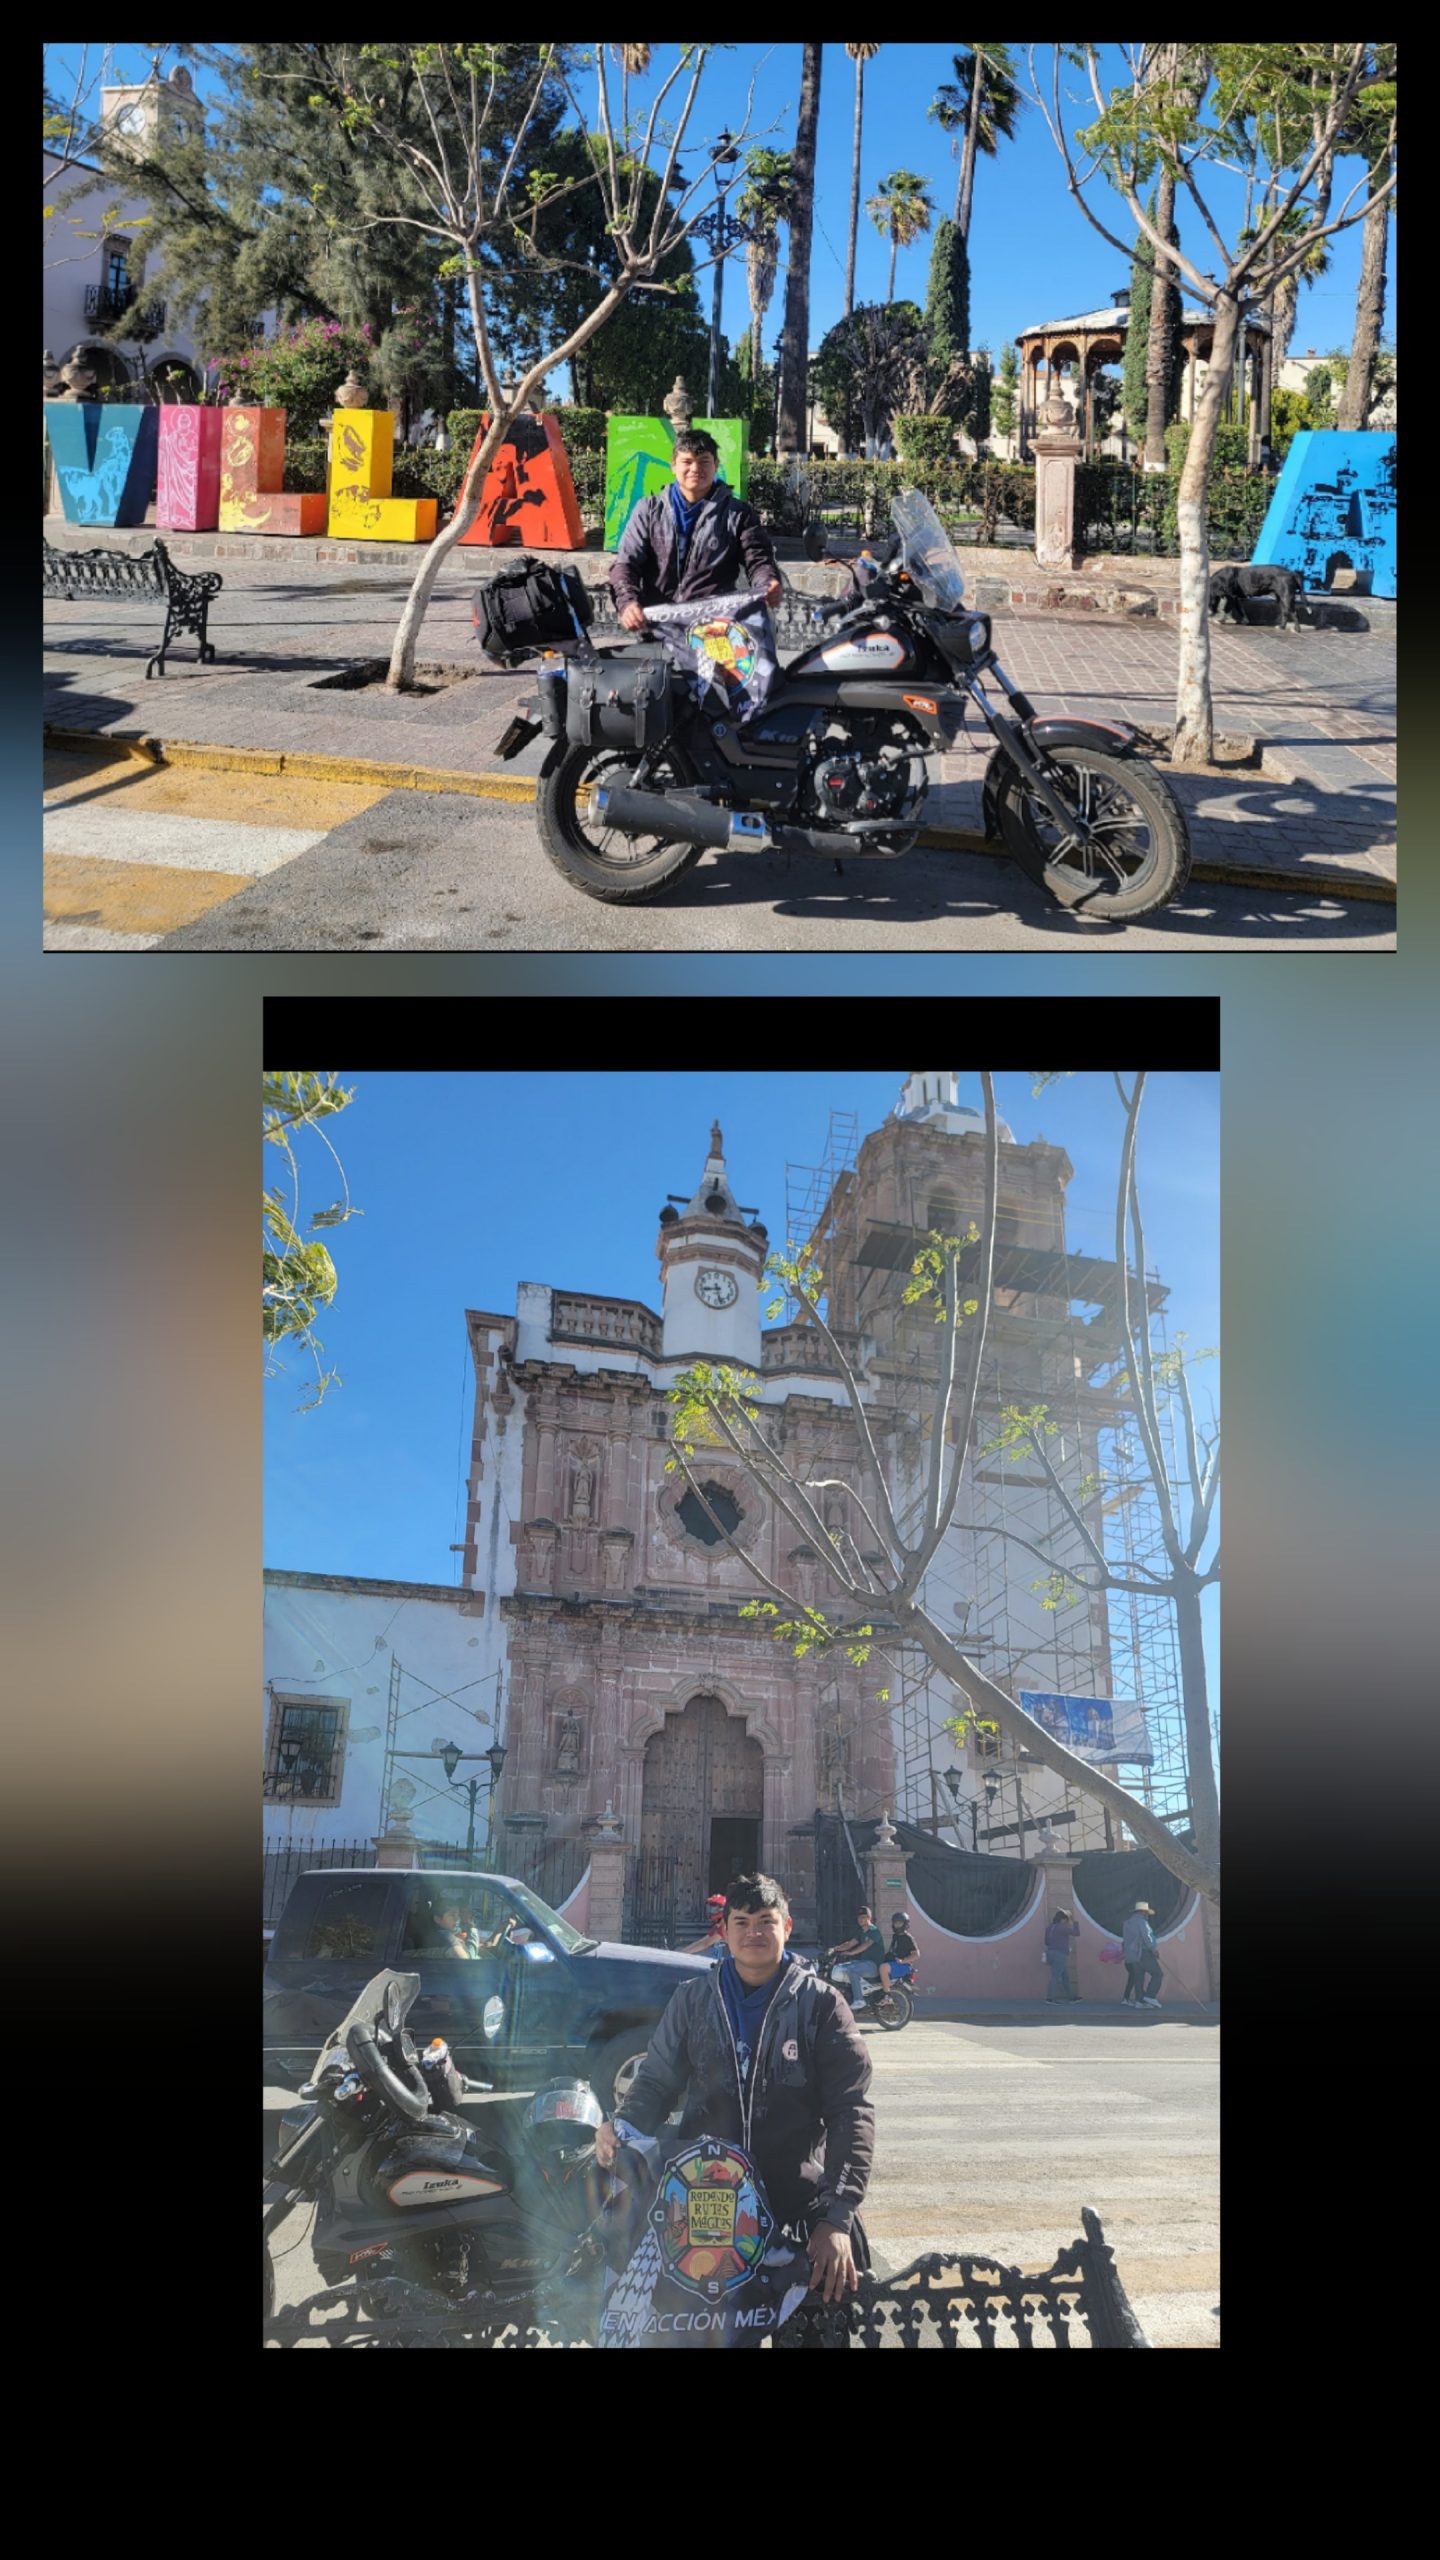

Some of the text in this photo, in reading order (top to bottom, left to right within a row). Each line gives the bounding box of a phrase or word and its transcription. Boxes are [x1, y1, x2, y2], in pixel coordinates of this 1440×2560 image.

[707, 2144, 721, 2156] N
[707, 2281, 720, 2294] S
[602, 2310, 638, 2332] EN
[643, 2307, 726, 2333] ACCIÓN
